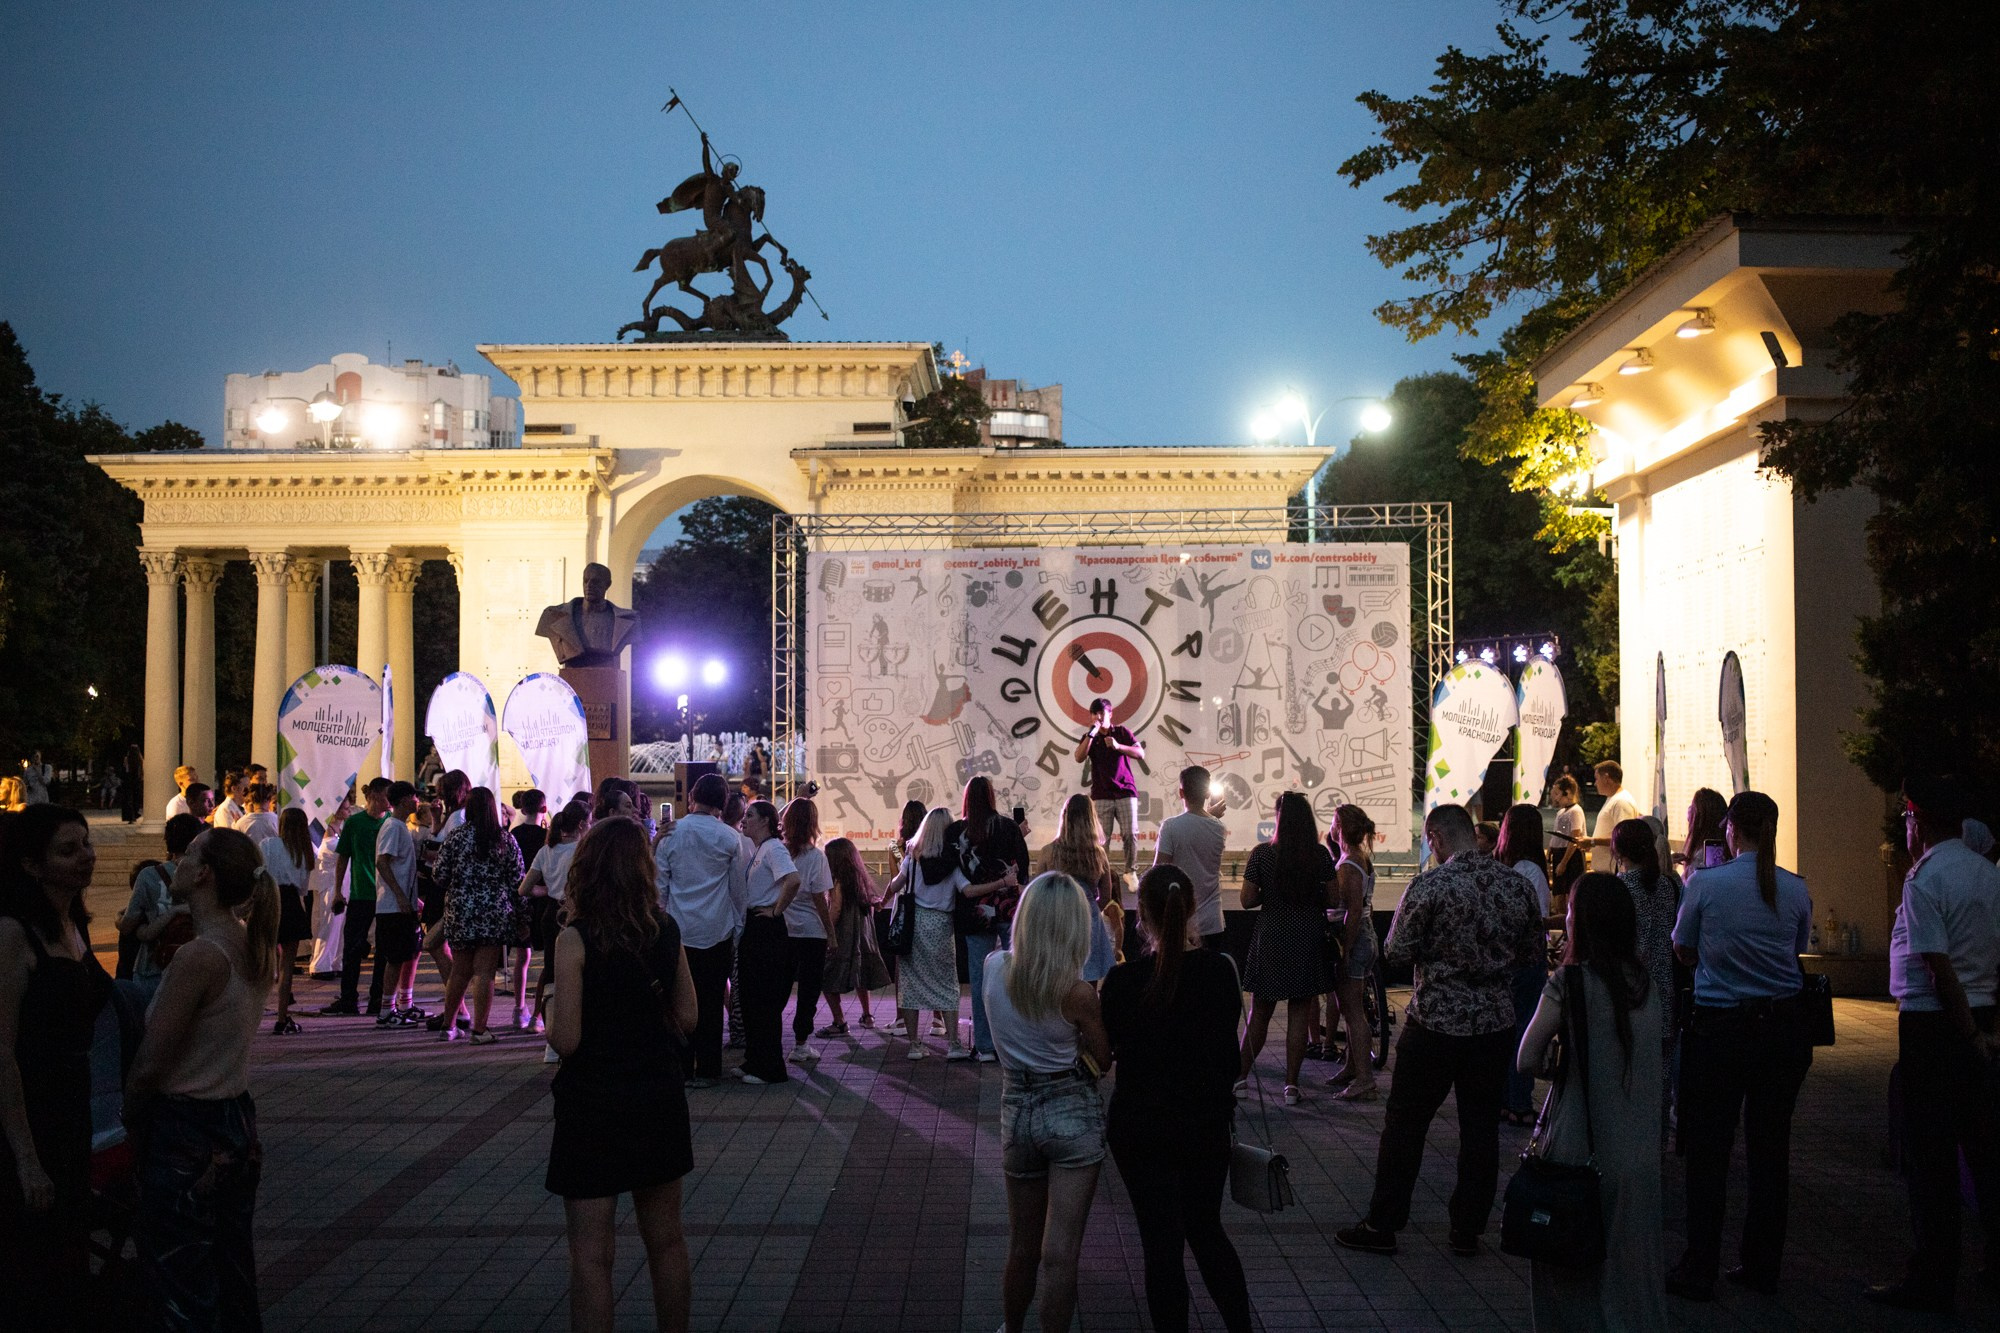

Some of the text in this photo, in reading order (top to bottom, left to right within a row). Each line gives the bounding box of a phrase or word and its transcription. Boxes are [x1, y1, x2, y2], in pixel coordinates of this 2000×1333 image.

[872, 558, 922, 571] @mol_krd
[943, 557, 1040, 571] @centr_sobitiy_krd
[1193, 552, 1243, 563] событий"
[1274, 552, 1378, 565] vk.com/centrsobitiy
[992, 577, 1203, 667] ЦЕНТР
[1441, 710, 1481, 727] МОЛЦЕНТР
[292, 719, 344, 735] МОЛЦЕНТР
[316, 733, 370, 748] КРАСНОДАР
[1457, 726, 1502, 744] КРАСНОДАР
[846, 829, 895, 840] @mol_krd
